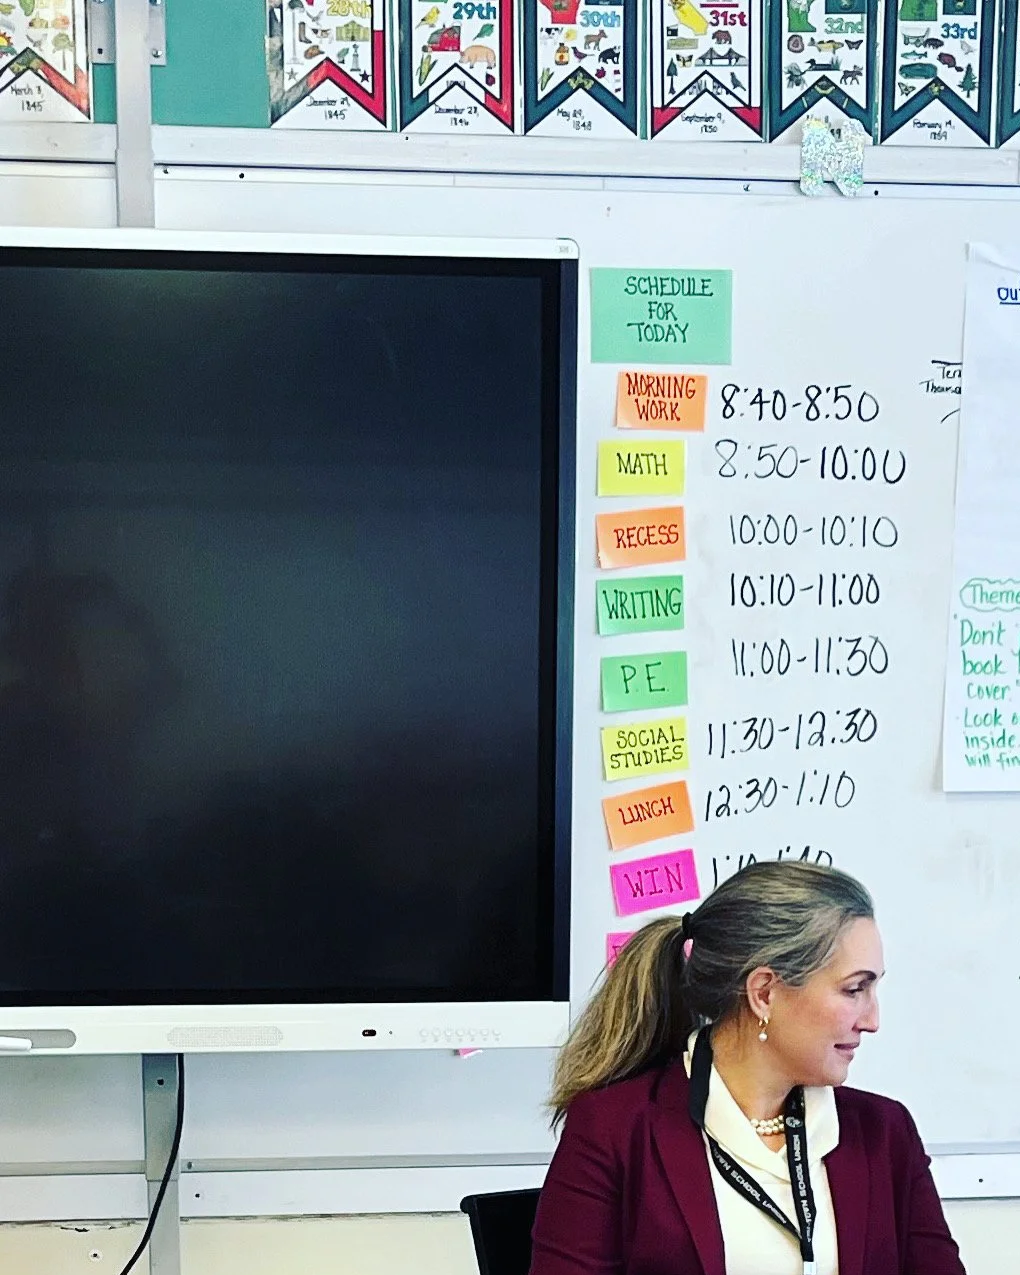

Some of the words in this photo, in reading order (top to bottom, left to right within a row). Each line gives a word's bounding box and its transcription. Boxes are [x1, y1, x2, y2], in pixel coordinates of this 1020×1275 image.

[453, 2, 497, 21] 29th
[579, 10, 621, 27] 30th
[709, 10, 748, 27] 31st
[824, 15, 865, 34] 32nd
[941, 22, 978, 40] 33rd
[624, 276, 714, 298] SCHEDULE
[648, 301, 678, 322] FOR
[627, 322, 689, 343] TODAY
[625, 373, 697, 398] MORNING
[634, 398, 683, 421] WORK
[720, 382, 880, 422] 8:40-8:50
[617, 452, 669, 476] MATH
[613, 523, 680, 550] RECESS
[729, 514, 898, 548] 10:00-10:10
[730, 572, 880, 608] 10:10-11:00
[602, 587, 682, 620] WRITING
[732, 635, 889, 677] 11:00-11:30
[962, 650, 1008, 676] book
[616, 724, 686, 748] SOCIAL
[708, 707, 878, 759] 11:30-12:30
[610, 745, 684, 770] STUDIES
[705, 769, 856, 822] 12:30-1:10
[618, 796, 675, 826] LUNCH
[624, 863, 684, 899] WIN
[792, 1134, 802, 1162] UNION
[730, 1169, 761, 1202] SCHOOL
[795, 1163, 807, 1197] SCHOOL
